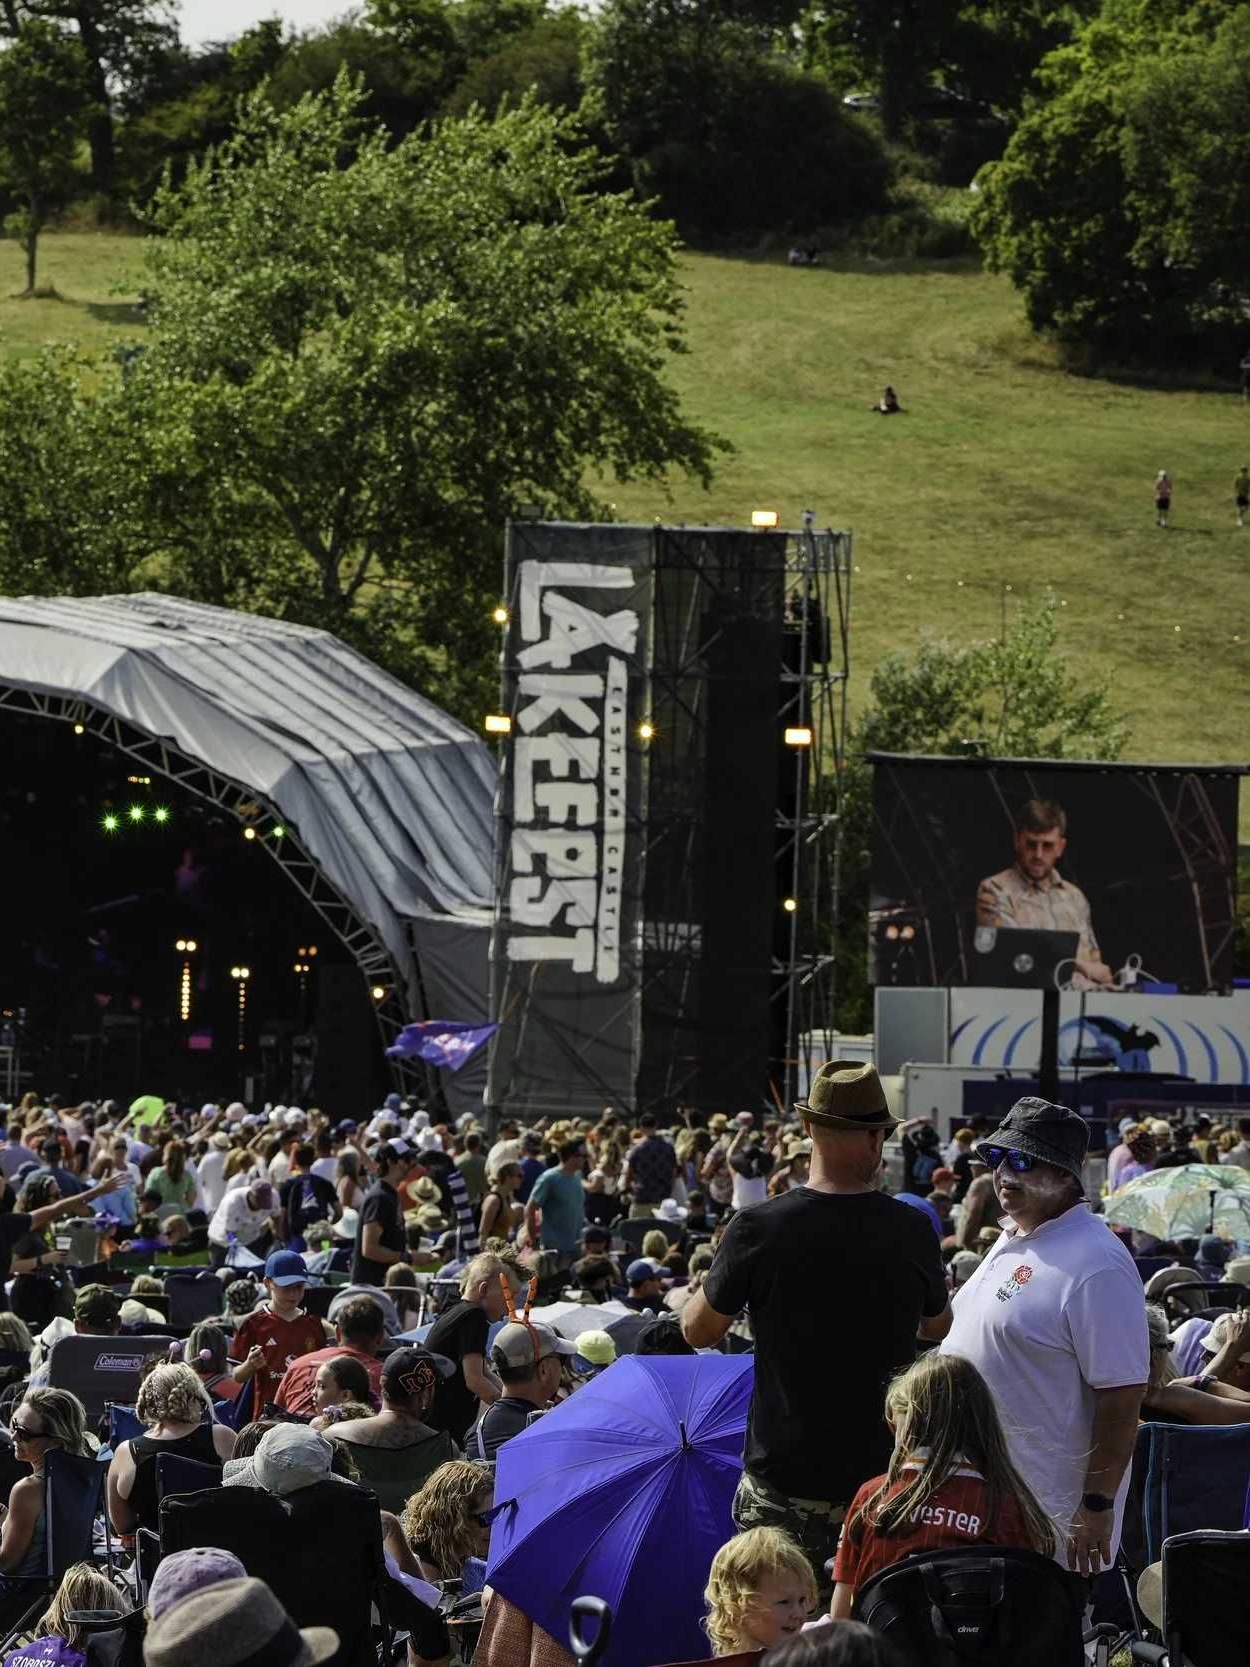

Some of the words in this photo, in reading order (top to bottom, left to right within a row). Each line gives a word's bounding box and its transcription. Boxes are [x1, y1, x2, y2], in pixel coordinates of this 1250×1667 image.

[507, 560, 639, 973] LAKEFEST
[603, 845, 619, 952] CASTLE
[99, 1355, 132, 1366] Coleman
